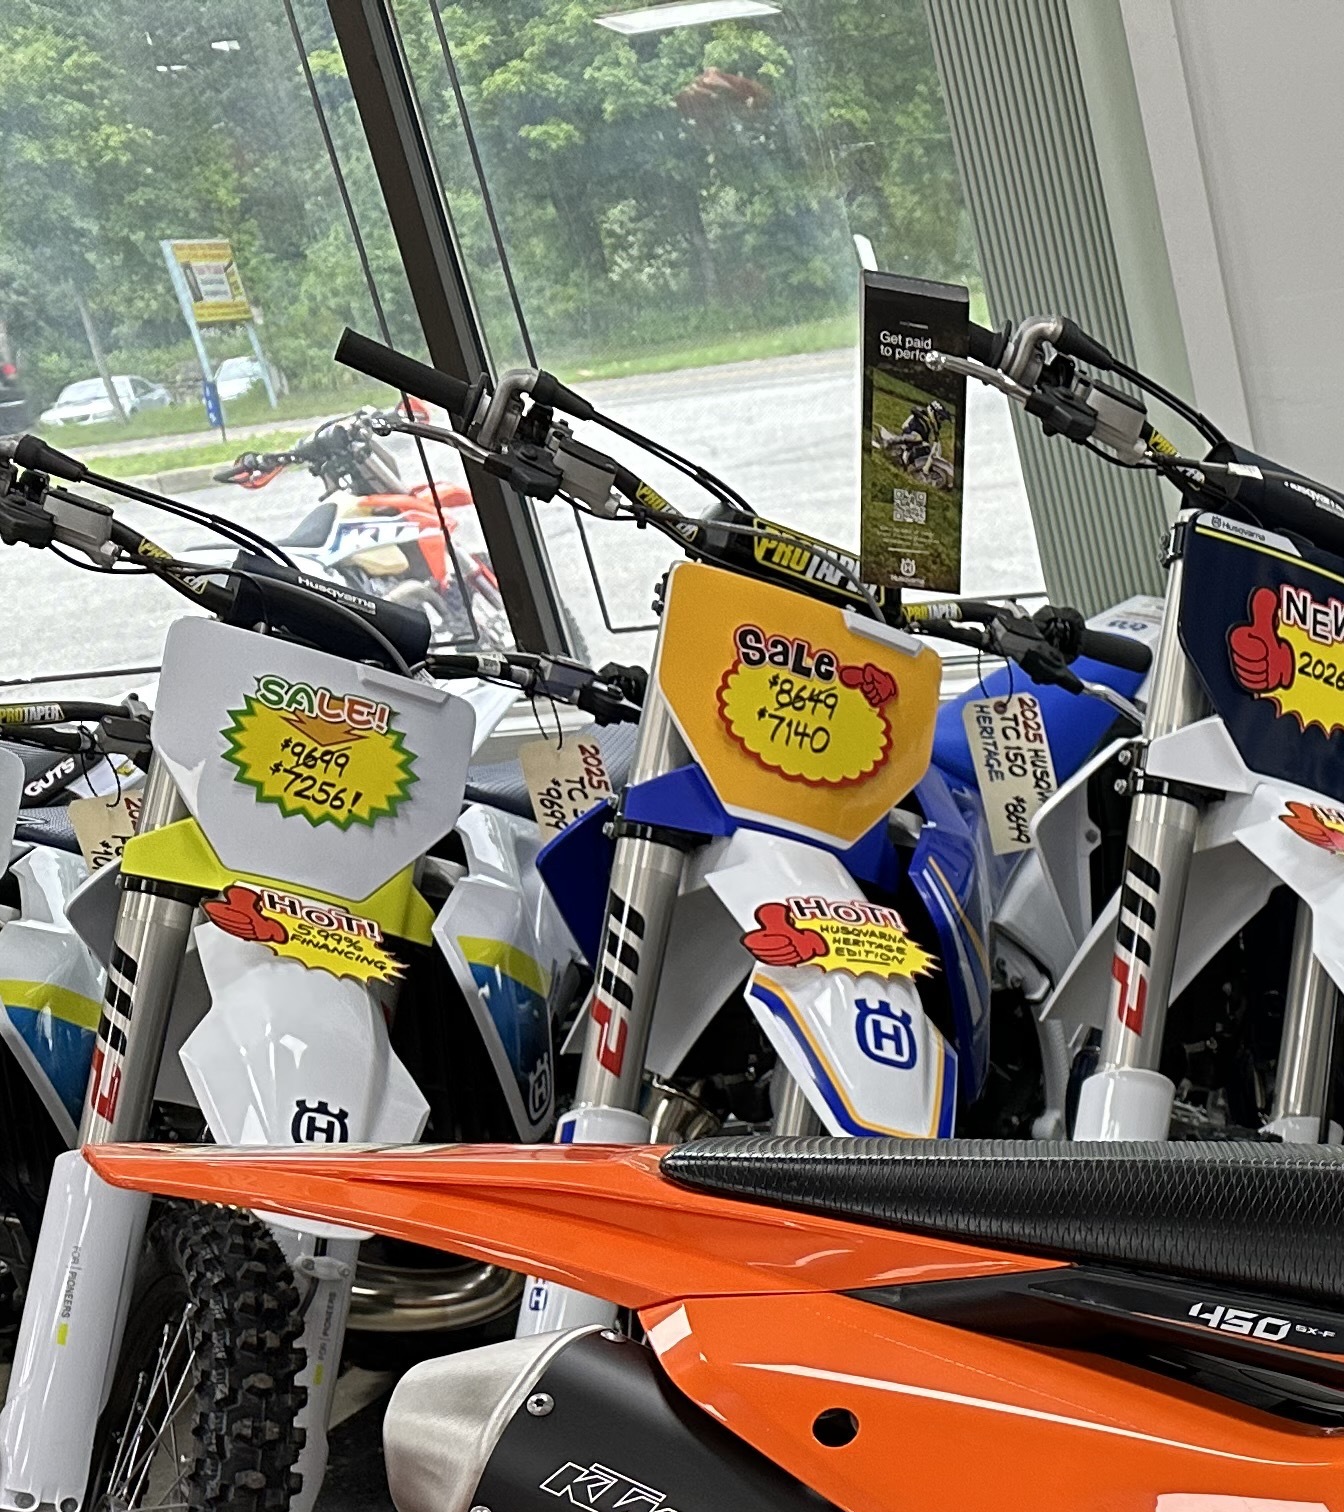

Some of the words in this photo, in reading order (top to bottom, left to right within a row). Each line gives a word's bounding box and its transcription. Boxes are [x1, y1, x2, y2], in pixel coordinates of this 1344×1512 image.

[880, 331, 902, 347] Get
[905, 336, 932, 352] paid
[880, 343, 892, 357] to
[895, 348, 929, 363] perfo
[1222, 521, 1267, 542] Husqvarna
[298, 576, 376, 609] Husqvarna
[736, 626, 838, 684] Sale
[0, 703, 63, 724] PROTAPER
[256, 675, 391, 735] SALE!
[768, 673, 839, 721] $8649
[757, 706, 831, 753] $7140
[1000, 713, 1021, 741] TC
[1017, 697, 1044, 745] 2025
[280, 737, 352, 778] $9699
[973, 703, 1005, 783] HERITAGE
[1003, 746, 1028, 778] 150
[24, 756, 76, 797] GUTS
[578, 744, 611, 792] 2025
[269, 761, 363, 814] $7256!
[564, 776, 589, 802] TC
[261, 889, 385, 944] HOT!
[788, 897, 909, 934] HOT!
[290, 933, 388, 972] FINANCING
[293, 923, 364, 952] 5.99%
[820, 924, 909, 948] HUSQVARNA
[832, 936, 908, 956] HERITAGE
[835, 946, 905, 966] EDITION
[1188, 1302, 1292, 1341] 450
